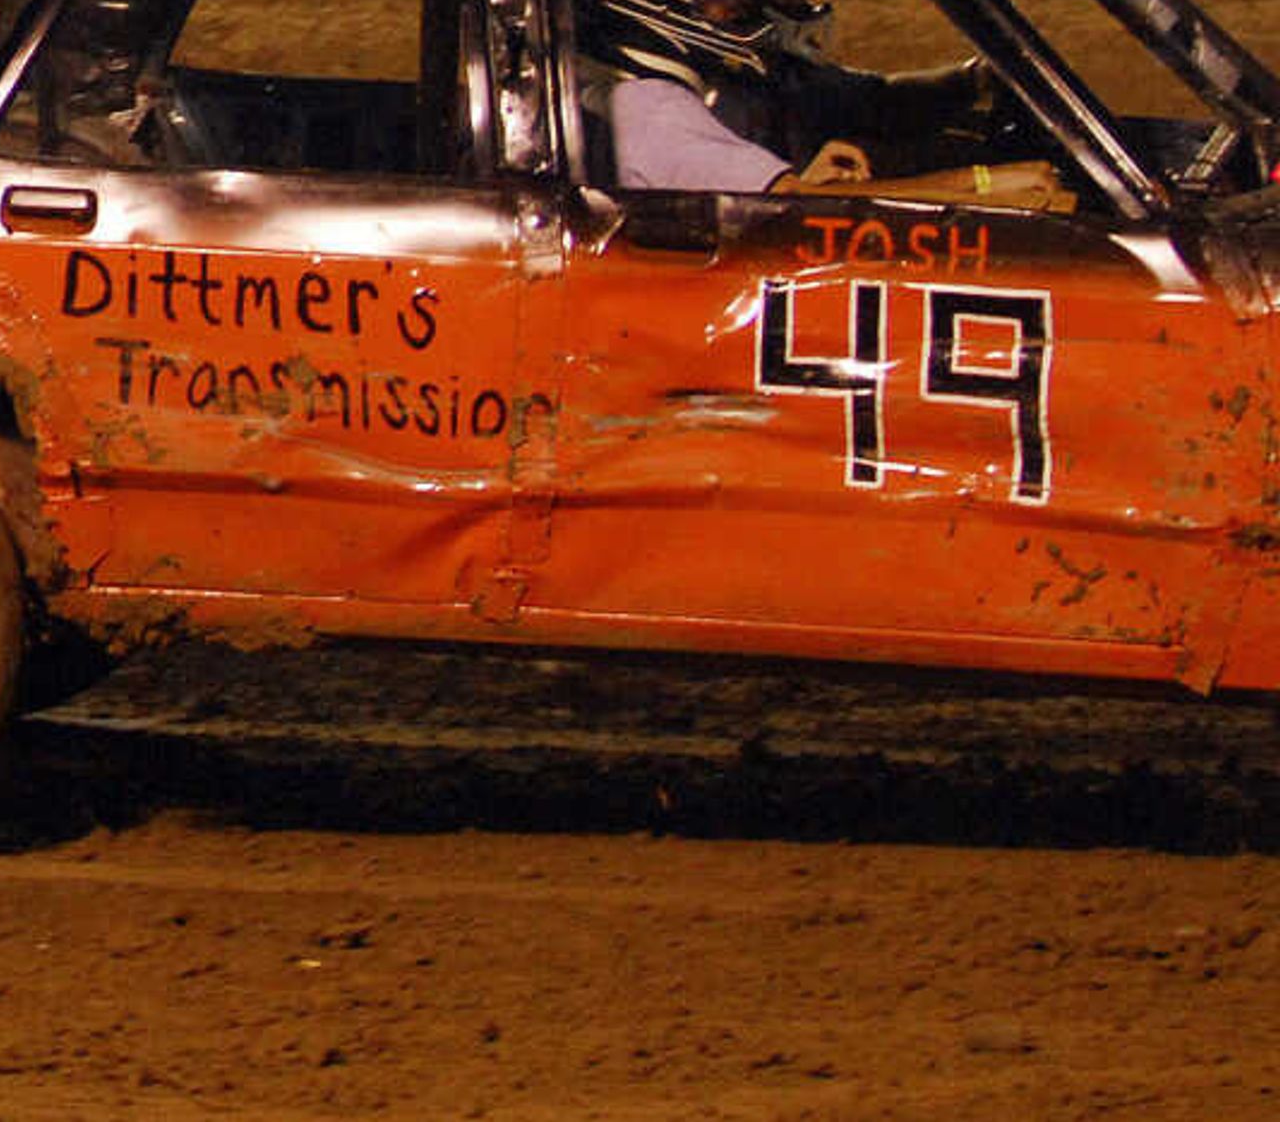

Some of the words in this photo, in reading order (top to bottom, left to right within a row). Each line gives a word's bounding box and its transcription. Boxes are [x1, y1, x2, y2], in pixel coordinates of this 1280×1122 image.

[794, 216, 990, 276] JOSH
[61, 250, 440, 350] Dittmer's
[95, 337, 562, 439] Transmission
[754, 276, 1053, 506] 49
